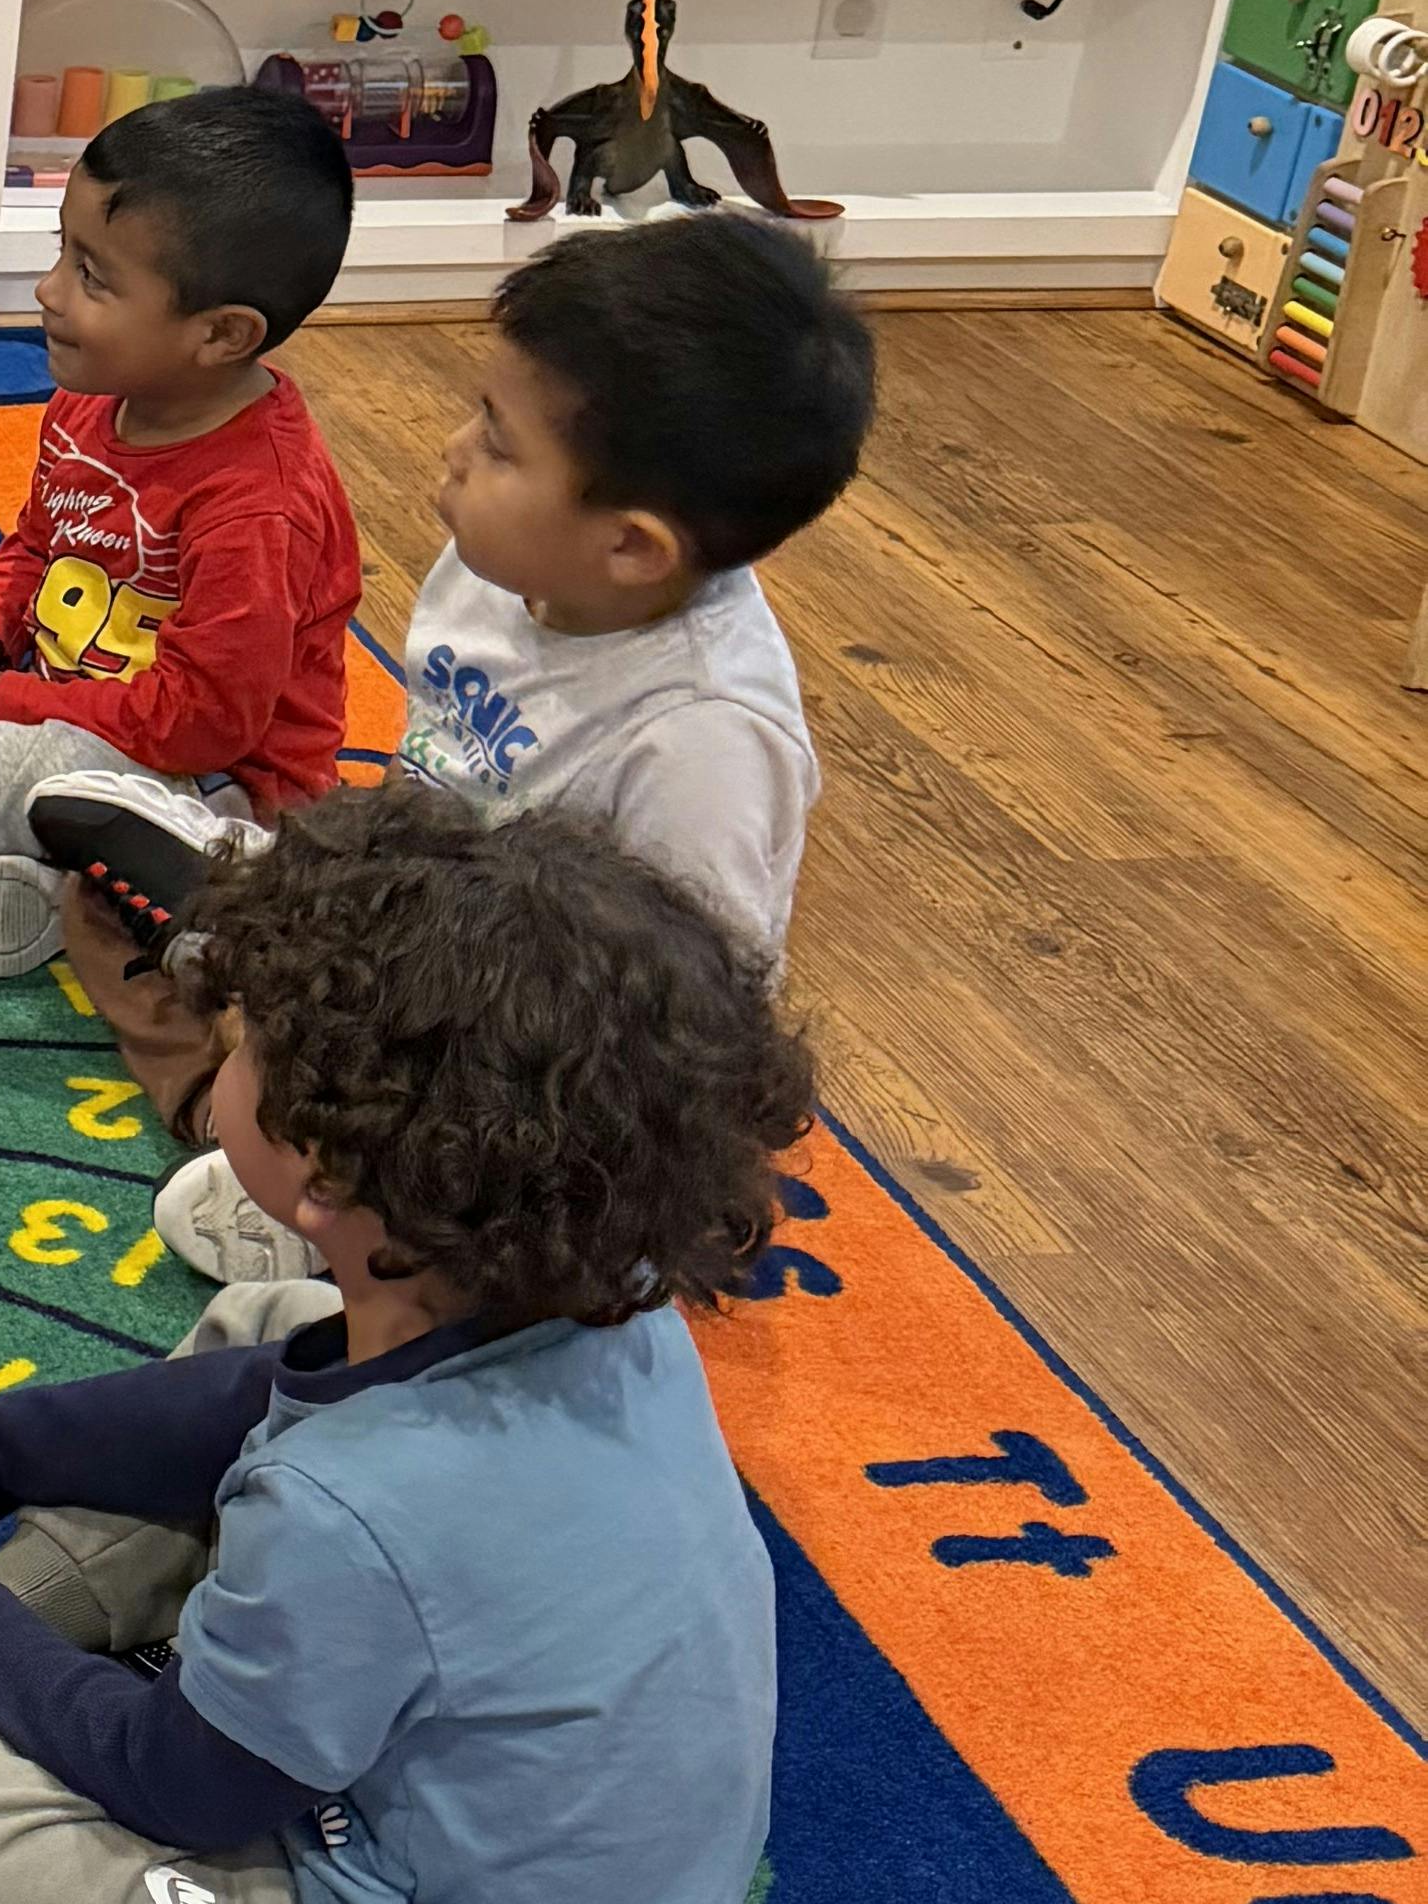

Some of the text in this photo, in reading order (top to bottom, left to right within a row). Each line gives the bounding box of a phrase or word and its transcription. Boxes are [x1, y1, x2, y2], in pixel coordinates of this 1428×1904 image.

[34, 554, 182, 684] 95
[422, 643, 540, 775] SONIC
[7, 1198, 165, 1288] 13
[864, 1430, 1119, 1578] Tt
